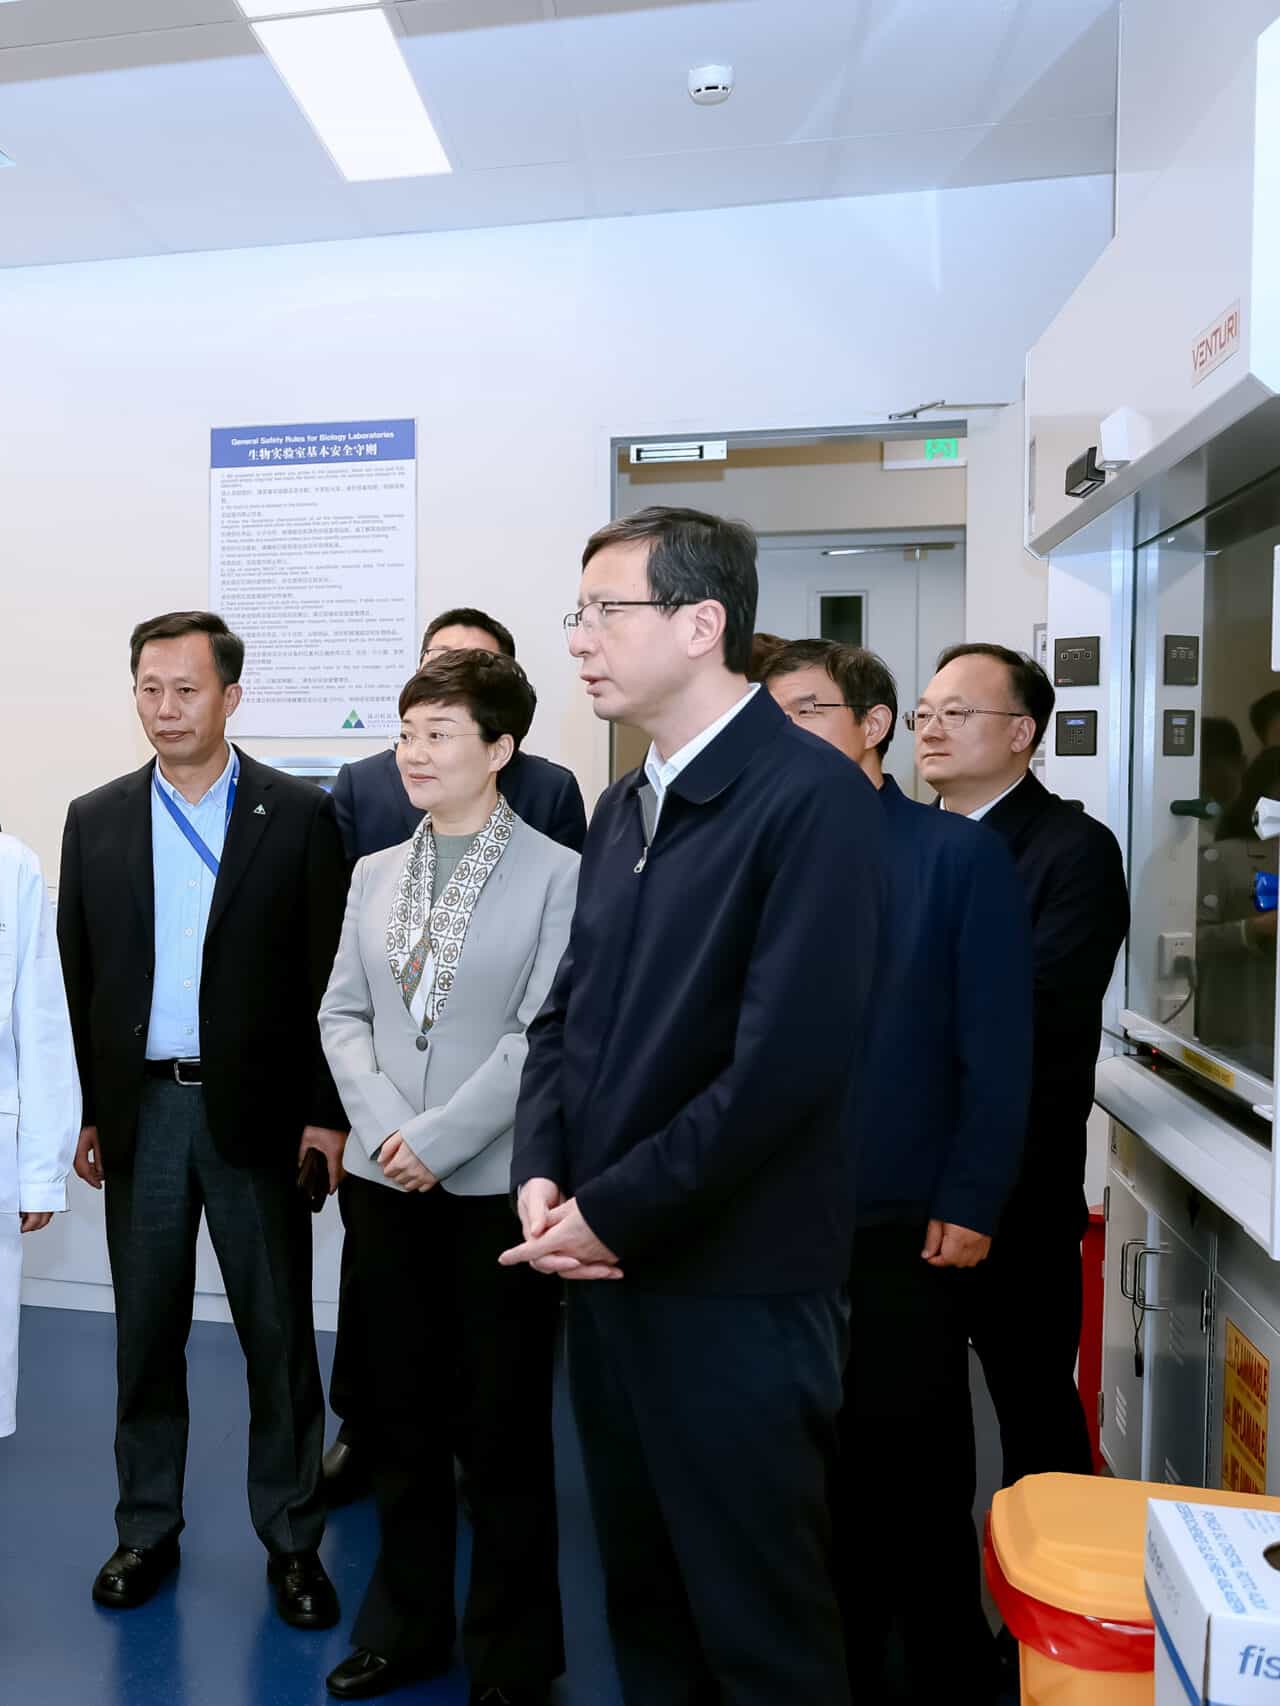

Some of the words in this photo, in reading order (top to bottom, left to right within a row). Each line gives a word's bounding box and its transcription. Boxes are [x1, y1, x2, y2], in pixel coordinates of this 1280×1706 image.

[1192, 311, 1238, 372] VENTURI
[231, 437, 260, 446] General
[260, 436, 284, 445] Safety
[285, 435, 306, 443] Rules
[307, 434, 318, 442] for
[319, 433, 347, 442] Biology
[348, 431, 395, 440] Laboratories
[248, 443, 378, 461] 生物实验室基本安全守则
